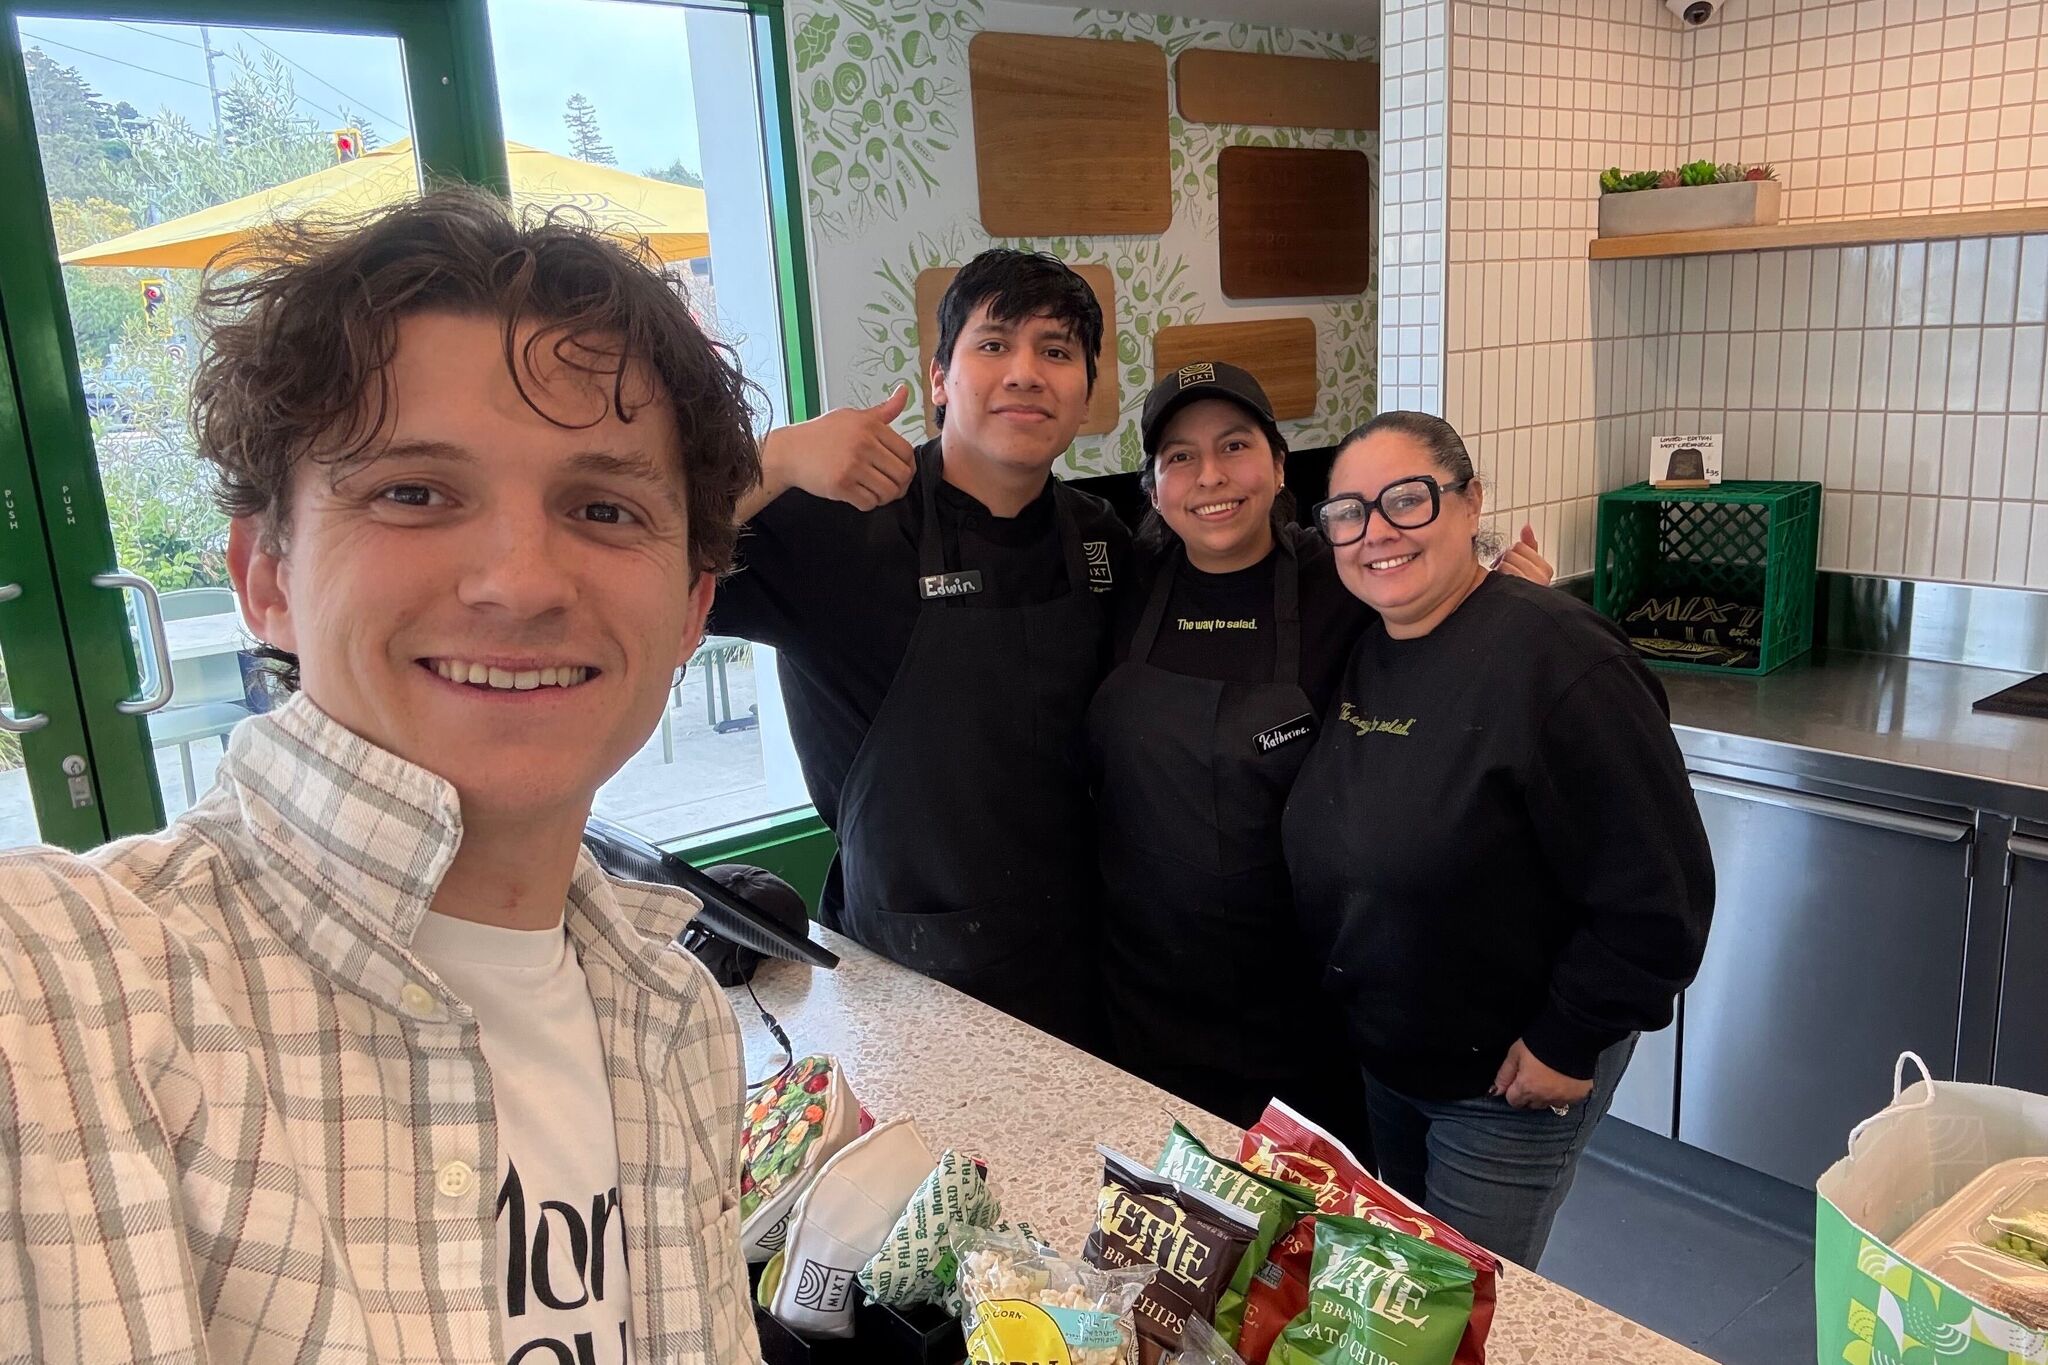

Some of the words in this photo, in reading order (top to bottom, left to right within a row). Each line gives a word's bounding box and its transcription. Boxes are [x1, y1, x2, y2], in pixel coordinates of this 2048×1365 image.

[1183, 373, 1210, 384] MIXT
[4, 489, 19, 530] PUSH
[62, 485, 76, 526] PUSH
[924, 575, 976, 597] Edwin
[1177, 618, 1194, 630] The
[1195, 620, 1214, 632] way
[1215, 618, 1226, 629] to
[1226, 618, 1258, 630] salad.
[827, 1274, 846, 1307] MIXT
[1077, 1312, 1109, 1330] SALT
[1321, 1299, 1364, 1330] BRAND
